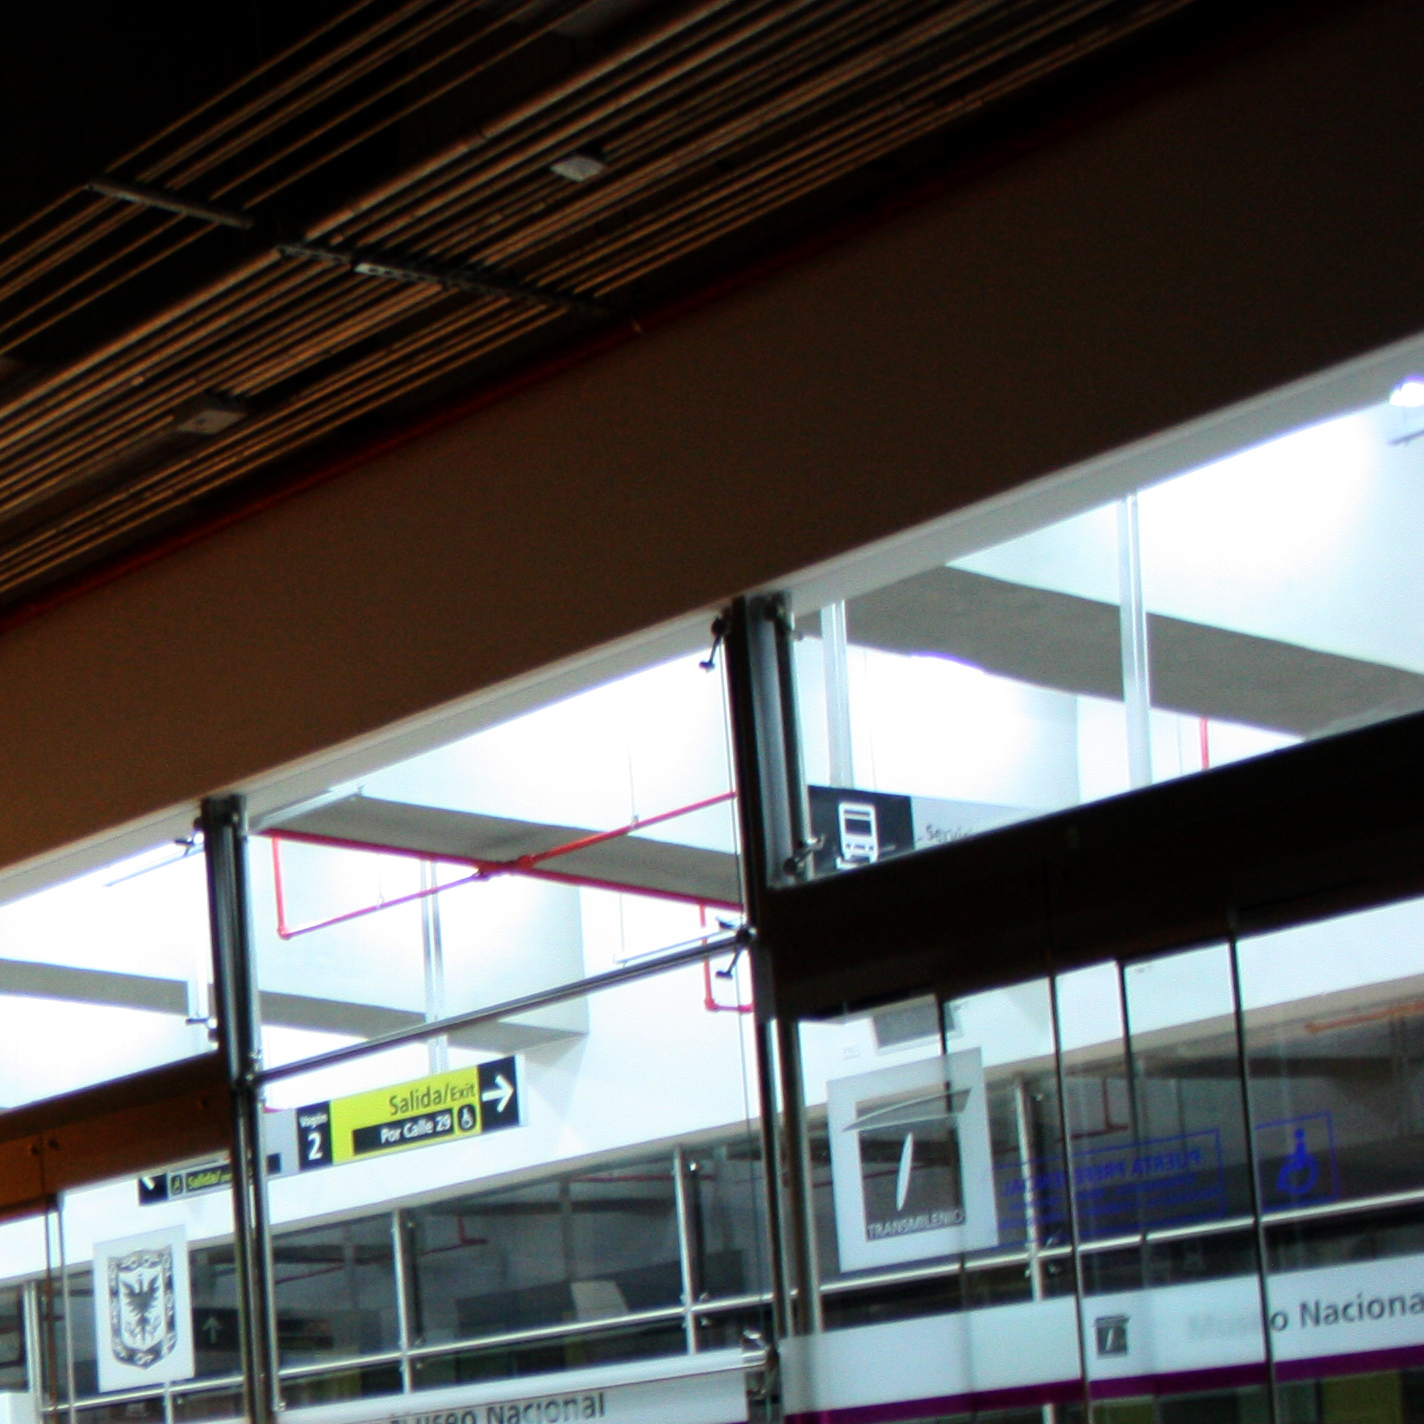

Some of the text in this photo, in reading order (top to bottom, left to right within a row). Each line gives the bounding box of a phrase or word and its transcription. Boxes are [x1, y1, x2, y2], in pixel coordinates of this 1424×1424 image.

[390, 1082, 476, 1117] Salida/Exit
[380, 1114, 452, 1145] Por Calle 29
[307, 1131, 324, 1161] 2
